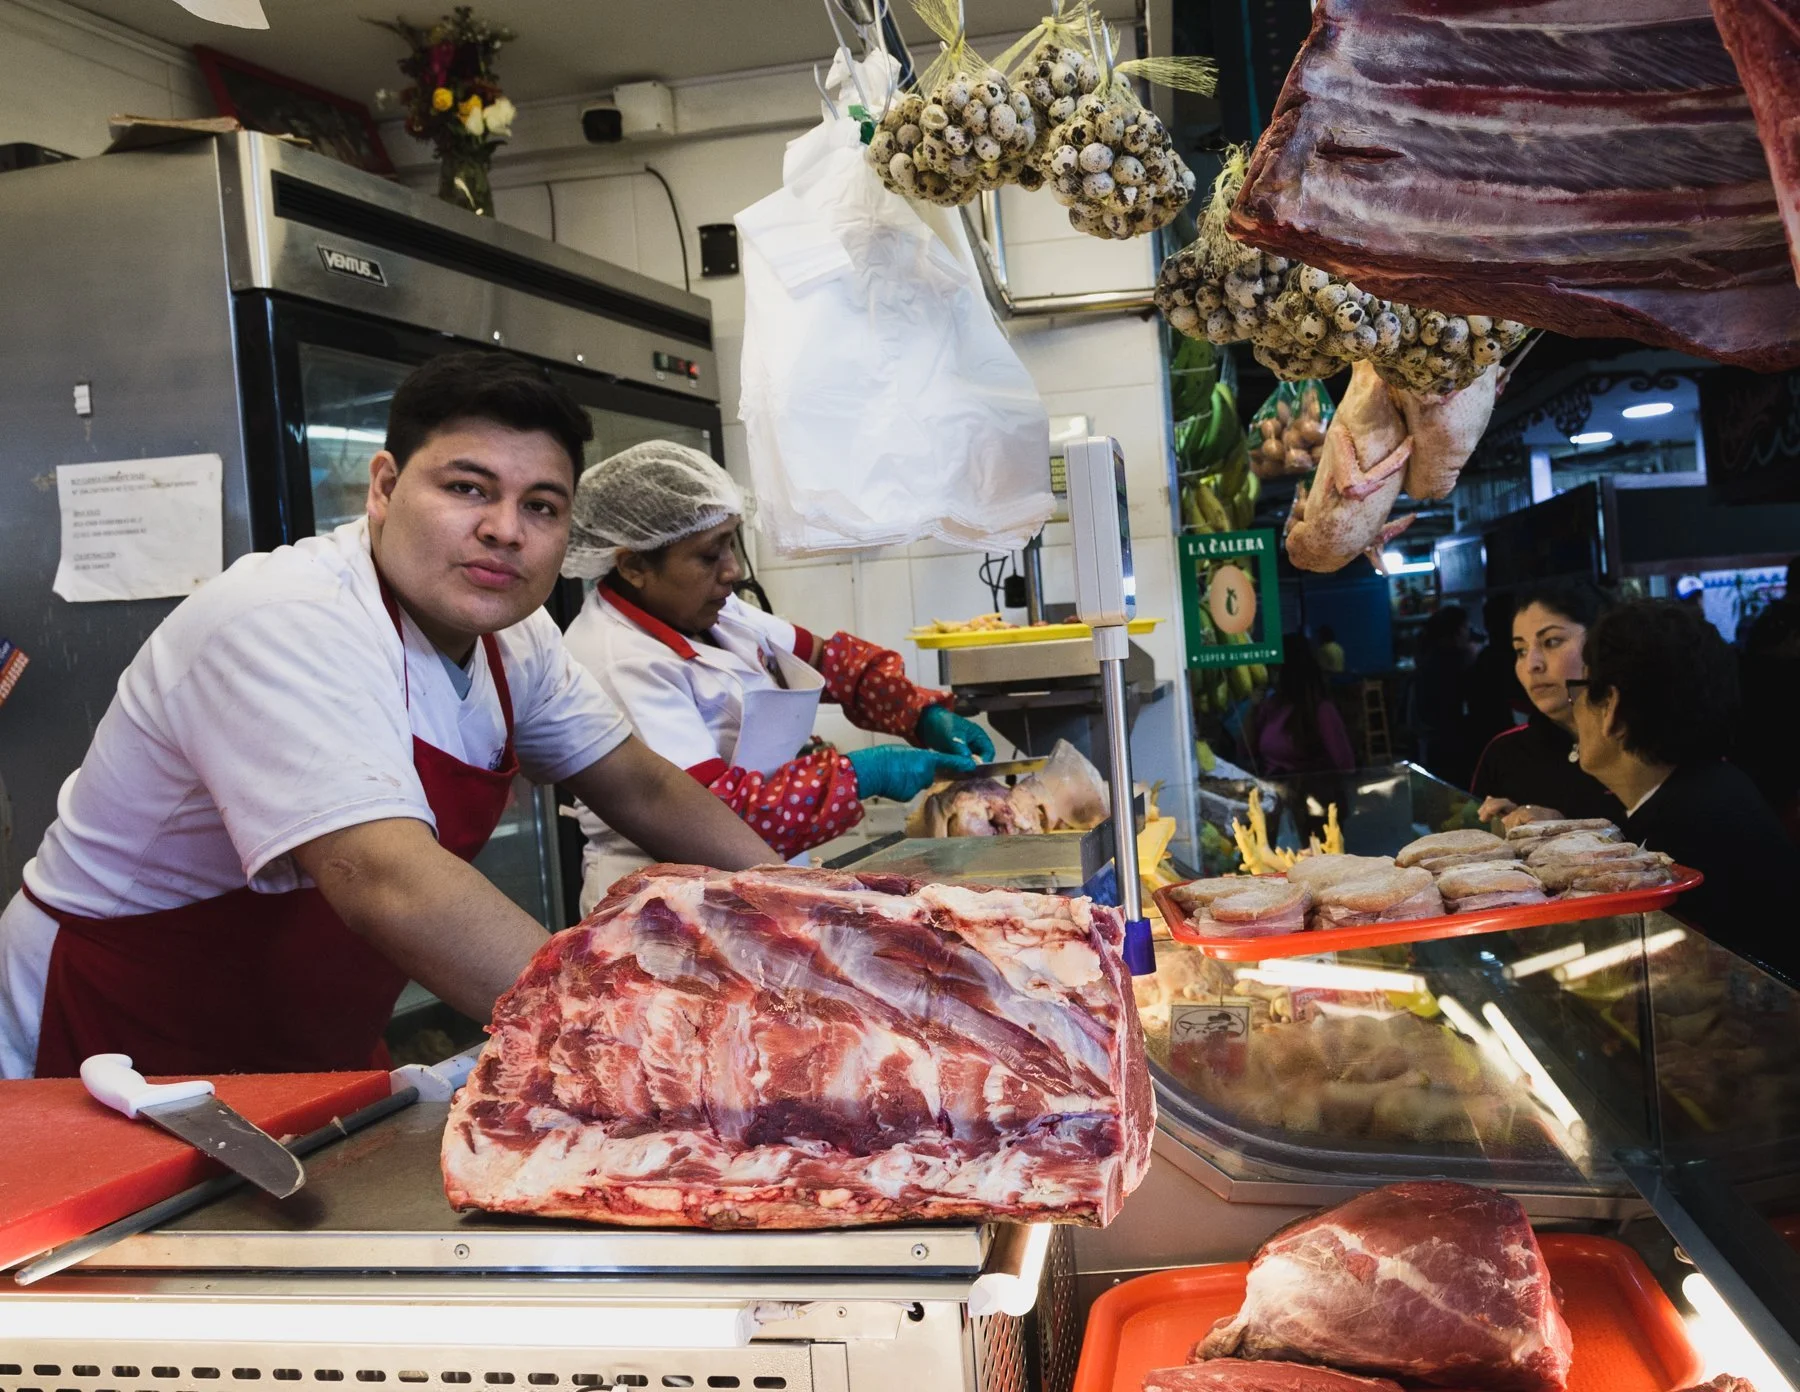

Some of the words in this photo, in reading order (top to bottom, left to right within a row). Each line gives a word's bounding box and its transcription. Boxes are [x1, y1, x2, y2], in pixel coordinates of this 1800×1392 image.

[323, 249, 371, 276] VENTUS
[1188, 542, 1206, 556] LA
[1209, 538, 1264, 554] CALERA
[1200, 652, 1226, 663] SUPER
[1229, 649, 1270, 661] ALIMENTO
